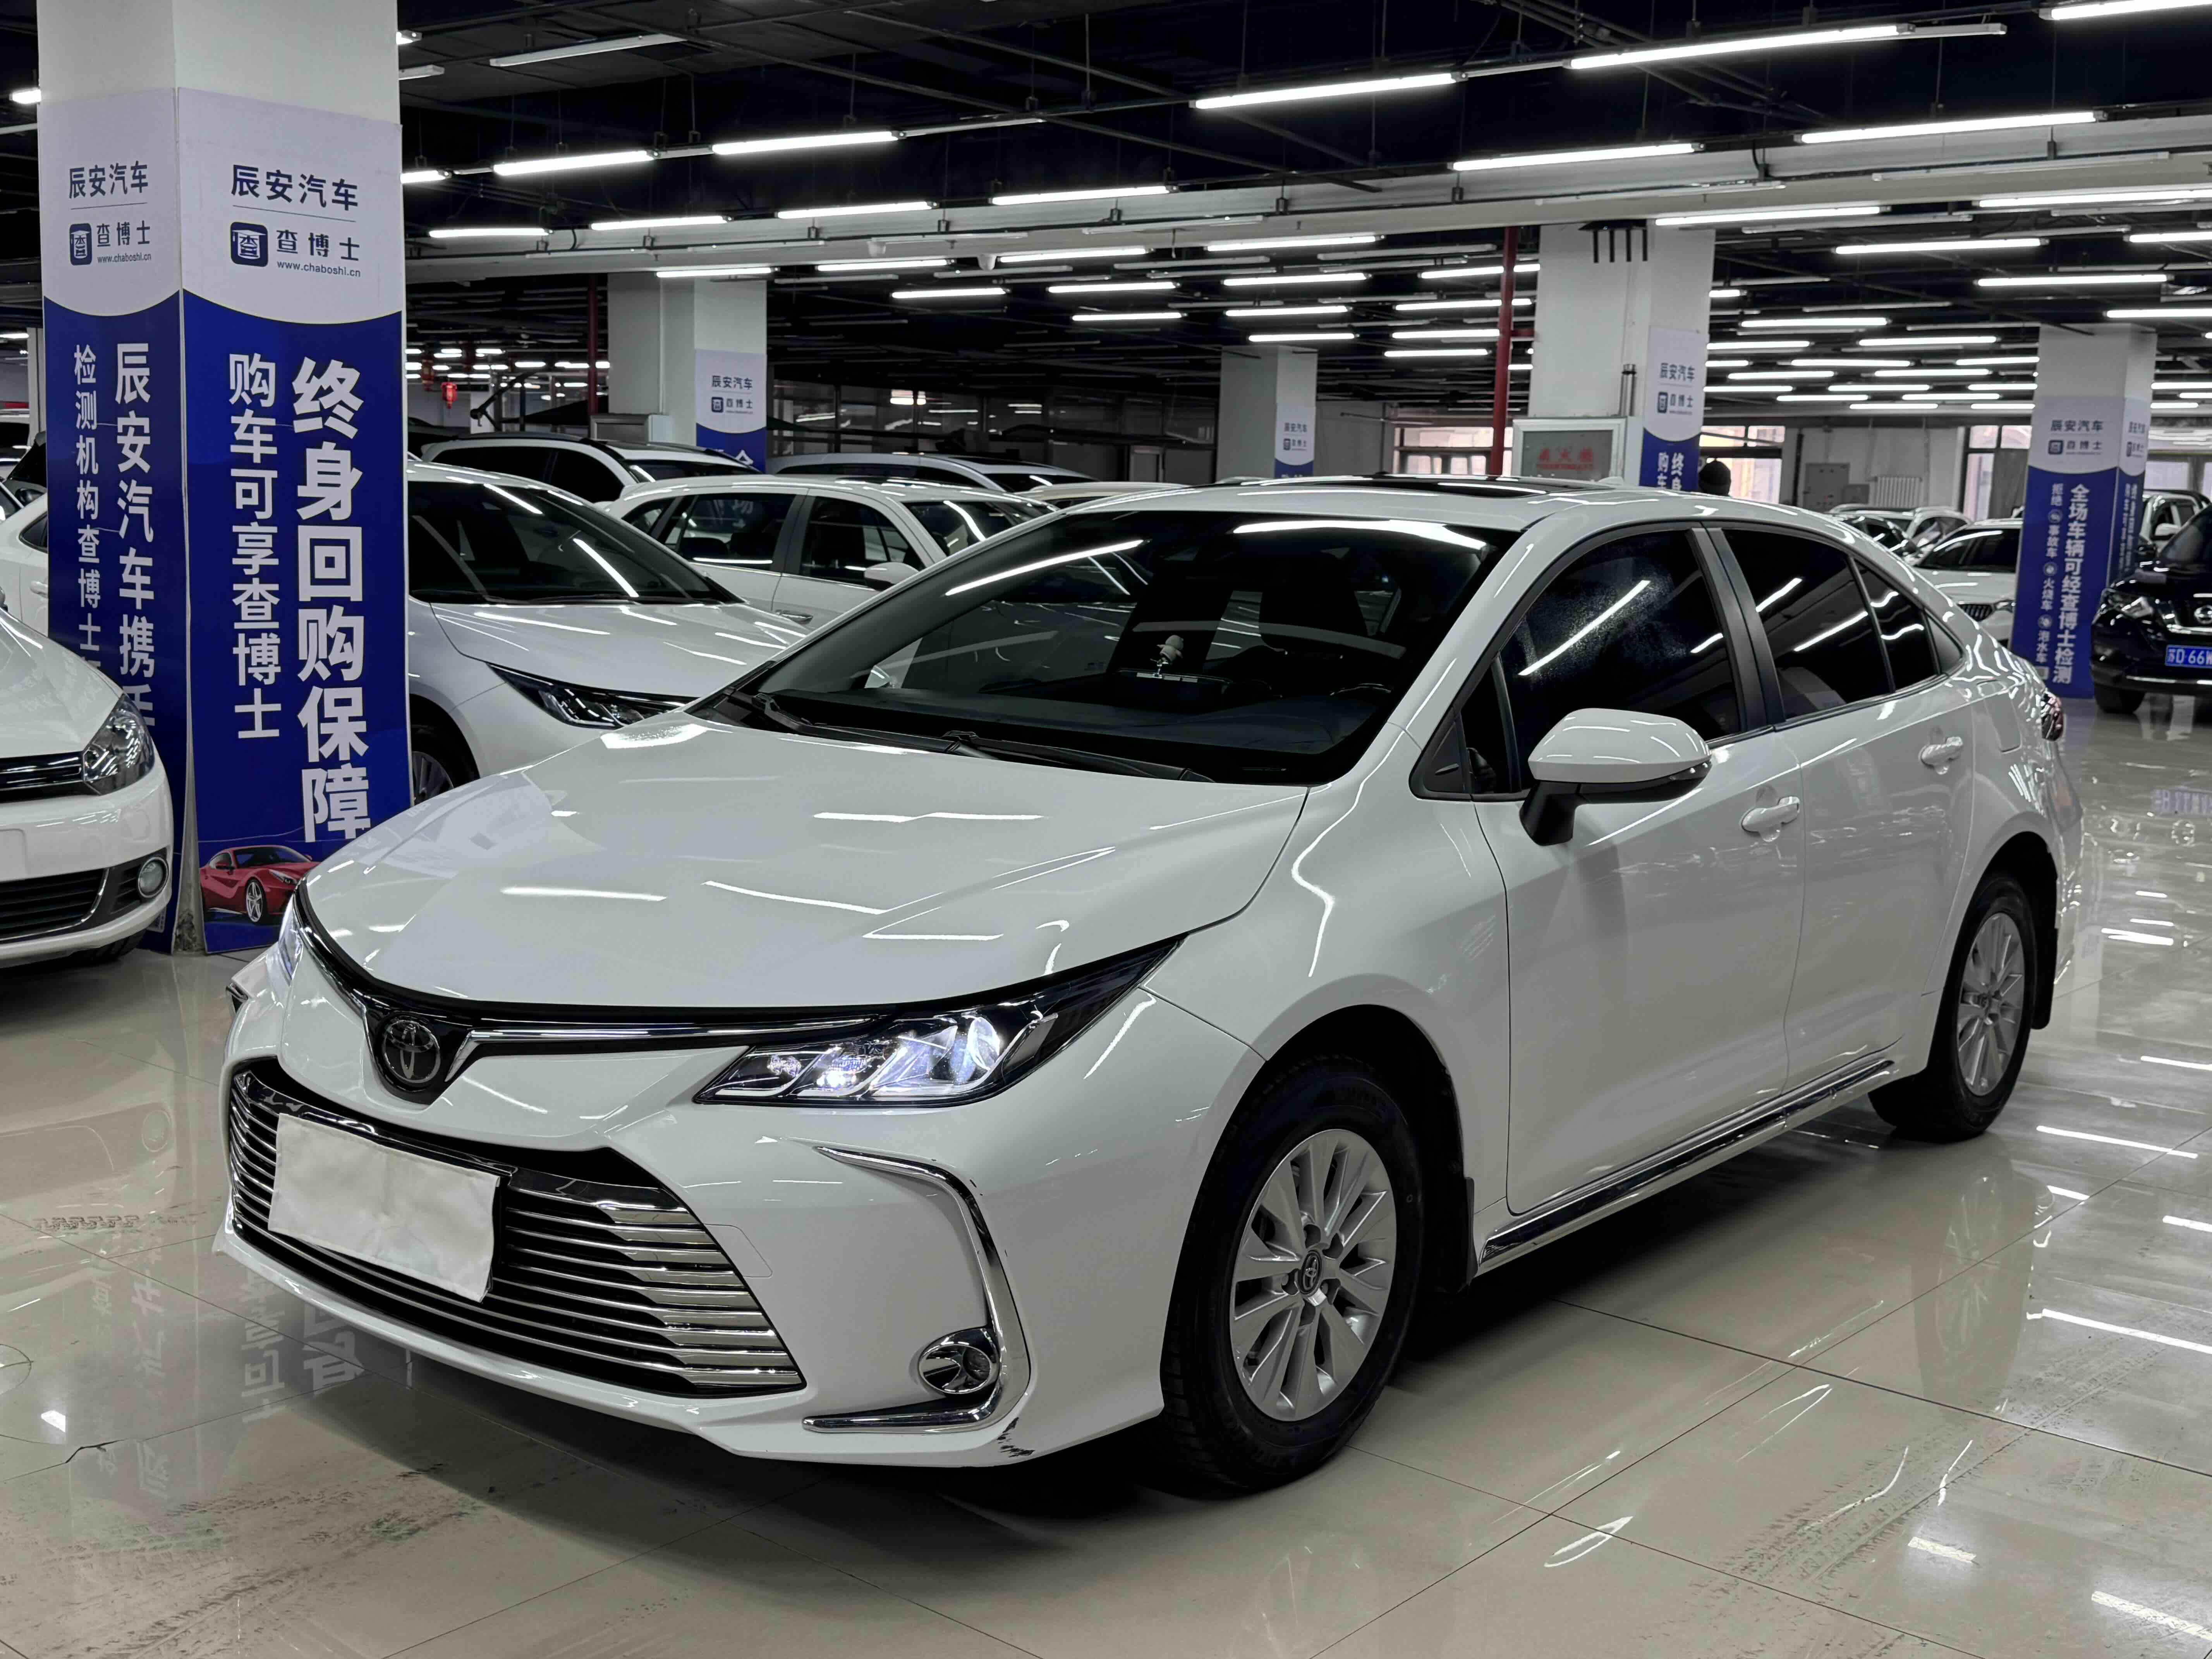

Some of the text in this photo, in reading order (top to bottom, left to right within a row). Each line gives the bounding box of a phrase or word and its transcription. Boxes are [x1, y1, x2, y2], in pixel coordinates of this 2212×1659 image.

[69, 160, 148, 199] 辰安汽车
[231, 165, 358, 211] 辰安汽车
[96, 220, 150, 247] 查博士
[276, 230, 360, 261] 查博士
[97, 252, 151, 263] www.chaboshi.cn
[276, 261, 361, 277] www.chaboshi.cn
[711, 375, 753, 390] 辰安汽车
[1660, 362, 1695, 381] 辰安汽车
[2051, 420, 2104, 432] 辰安汽车
[74, 344, 101, 668] 检测机构查博士
[228, 353, 281, 739] 购车可享查博士
[292, 356, 371, 843] 终身回购保障
